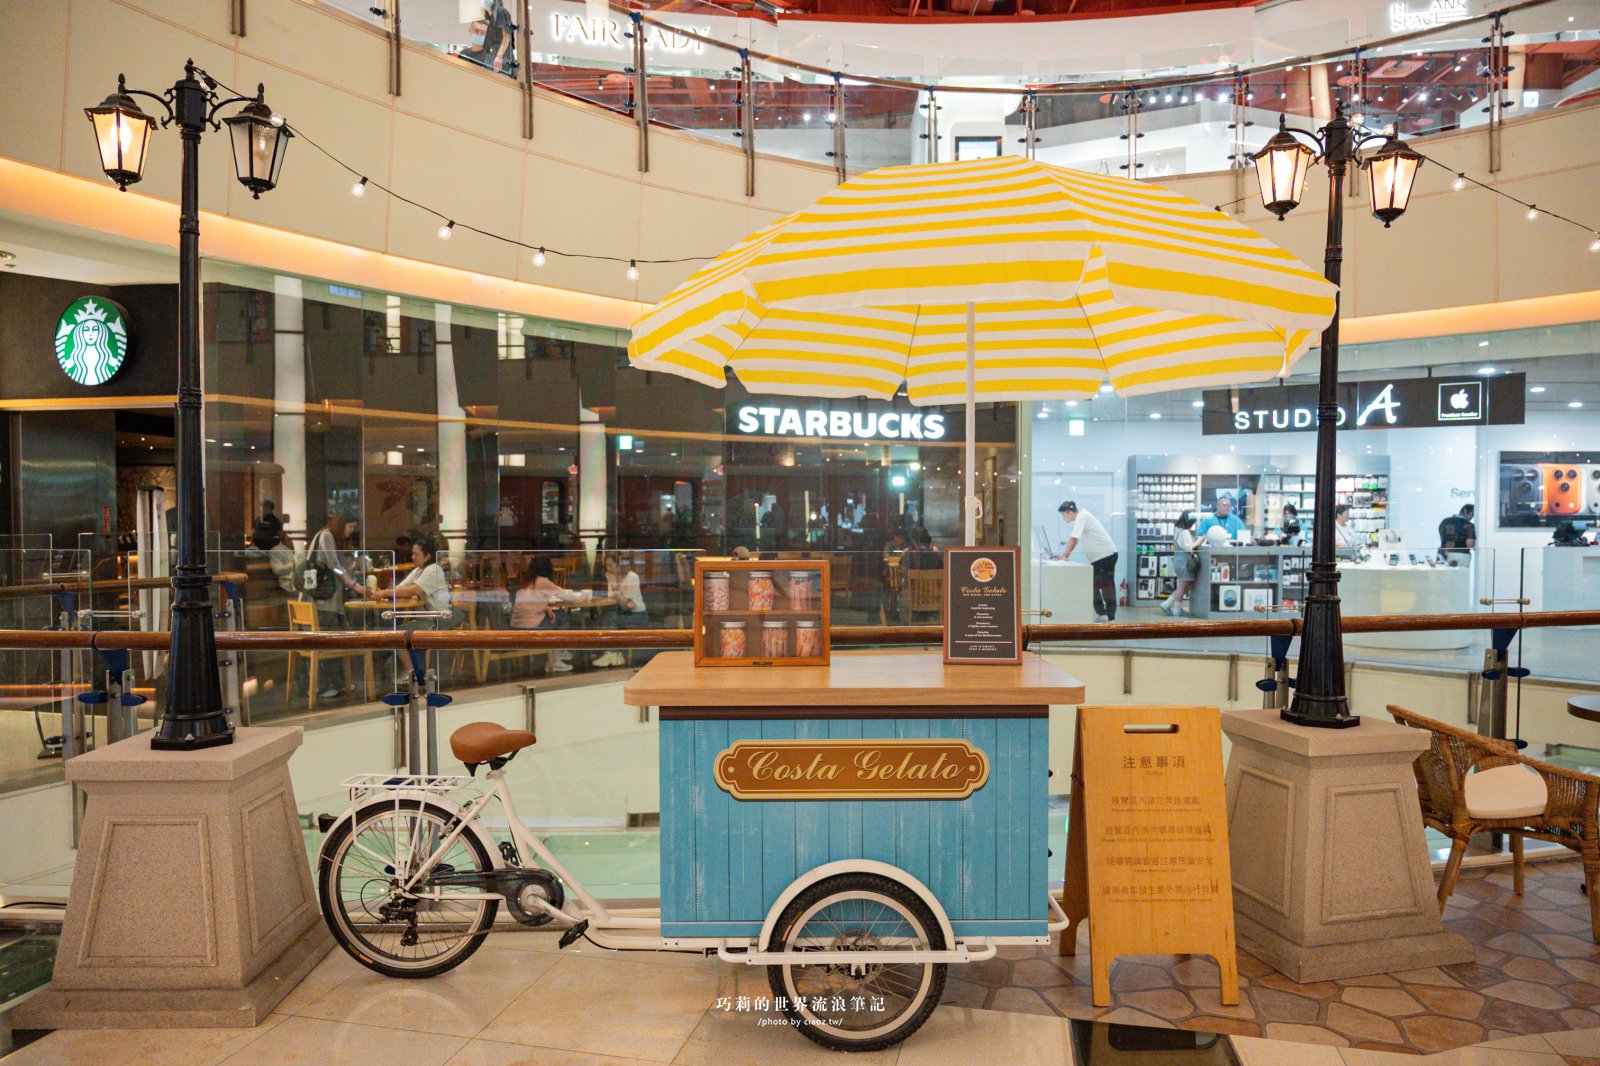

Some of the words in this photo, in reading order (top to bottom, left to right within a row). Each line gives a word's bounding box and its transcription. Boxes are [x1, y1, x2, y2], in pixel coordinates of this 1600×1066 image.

[553, 13, 623, 47] FAIR
[1356, 383, 1401, 426] A
[738, 406, 945, 439] STARBUCKS
[747, 751, 845, 780] Costa
[854, 750, 966, 780] Gelato
[1123, 756, 1185, 768] 注意事項
